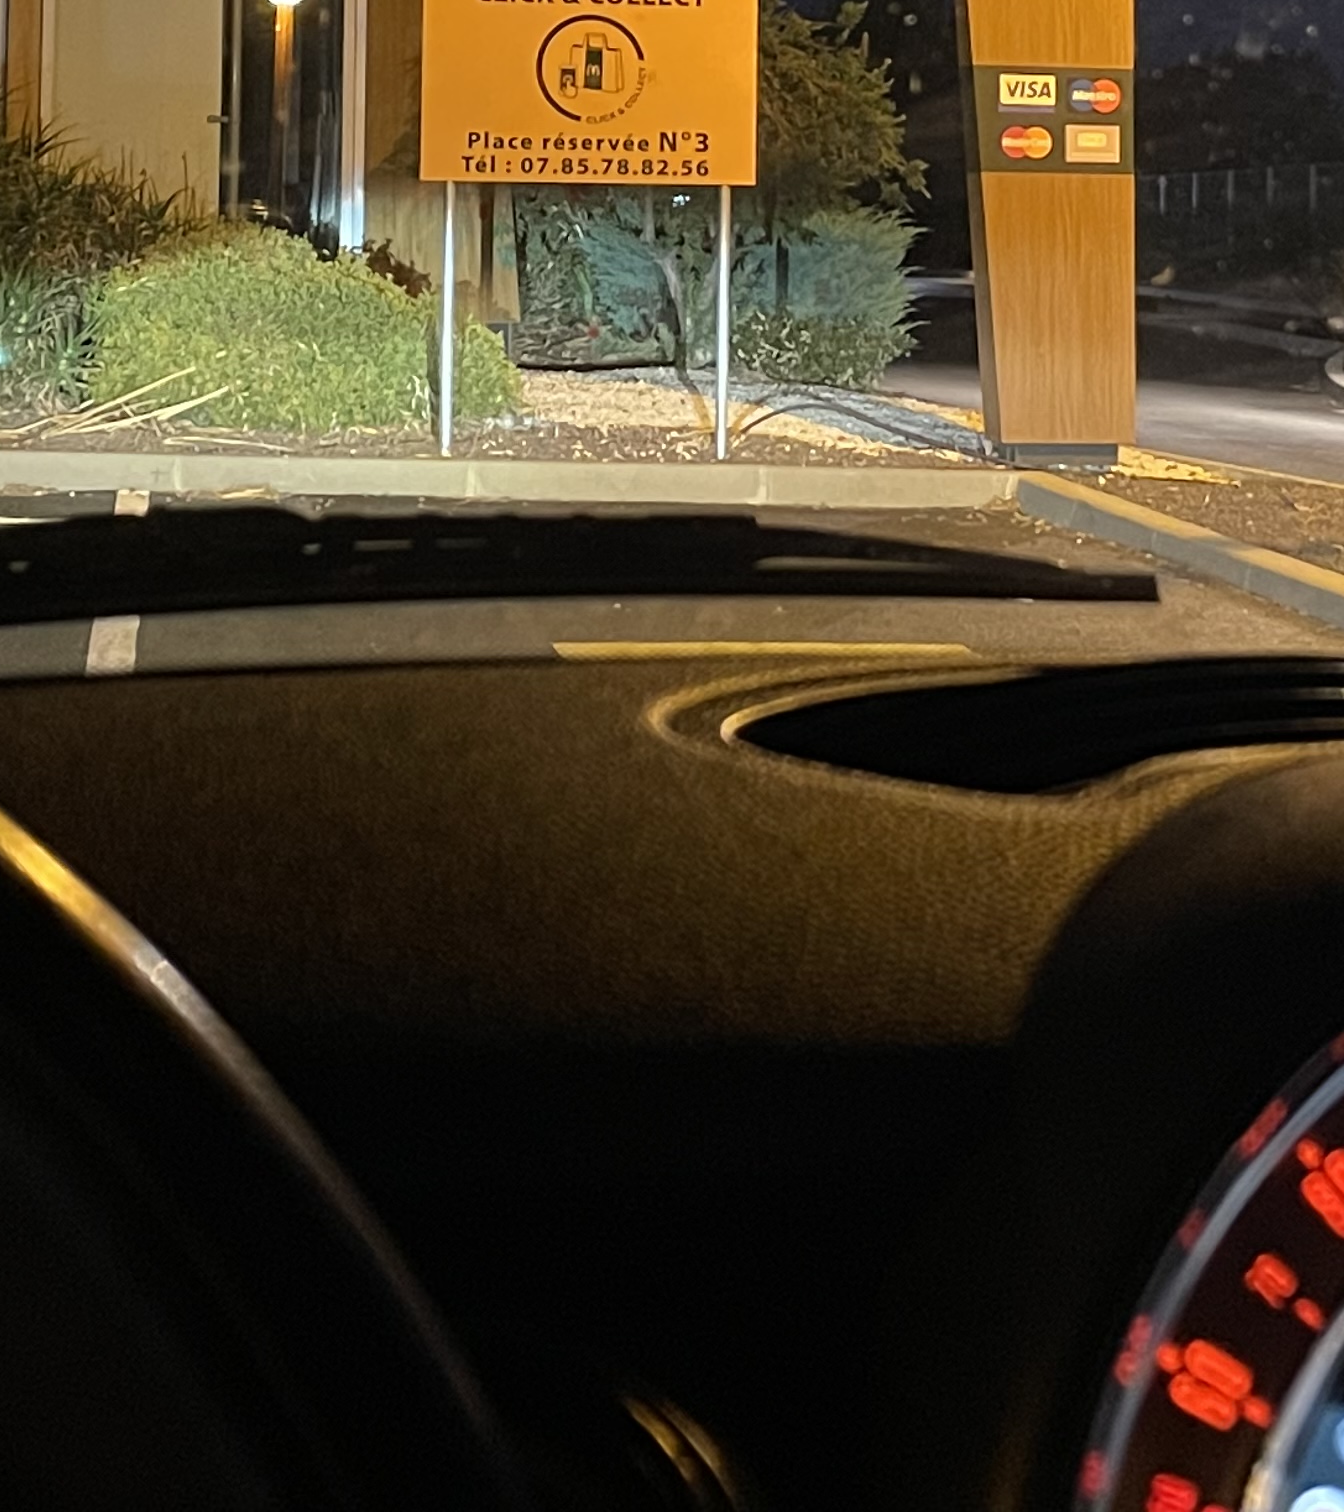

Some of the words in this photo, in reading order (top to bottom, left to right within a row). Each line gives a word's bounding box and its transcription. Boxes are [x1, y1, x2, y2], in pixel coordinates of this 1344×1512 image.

[1006, 80, 1052, 99] VISA
[467, 131, 533, 150] Place
[542, 132, 650, 153] réservée
[659, 131, 709, 153] N°3
[461, 155, 496, 174] Tél
[520, 157, 709, 177] 07.85.78.82.56
